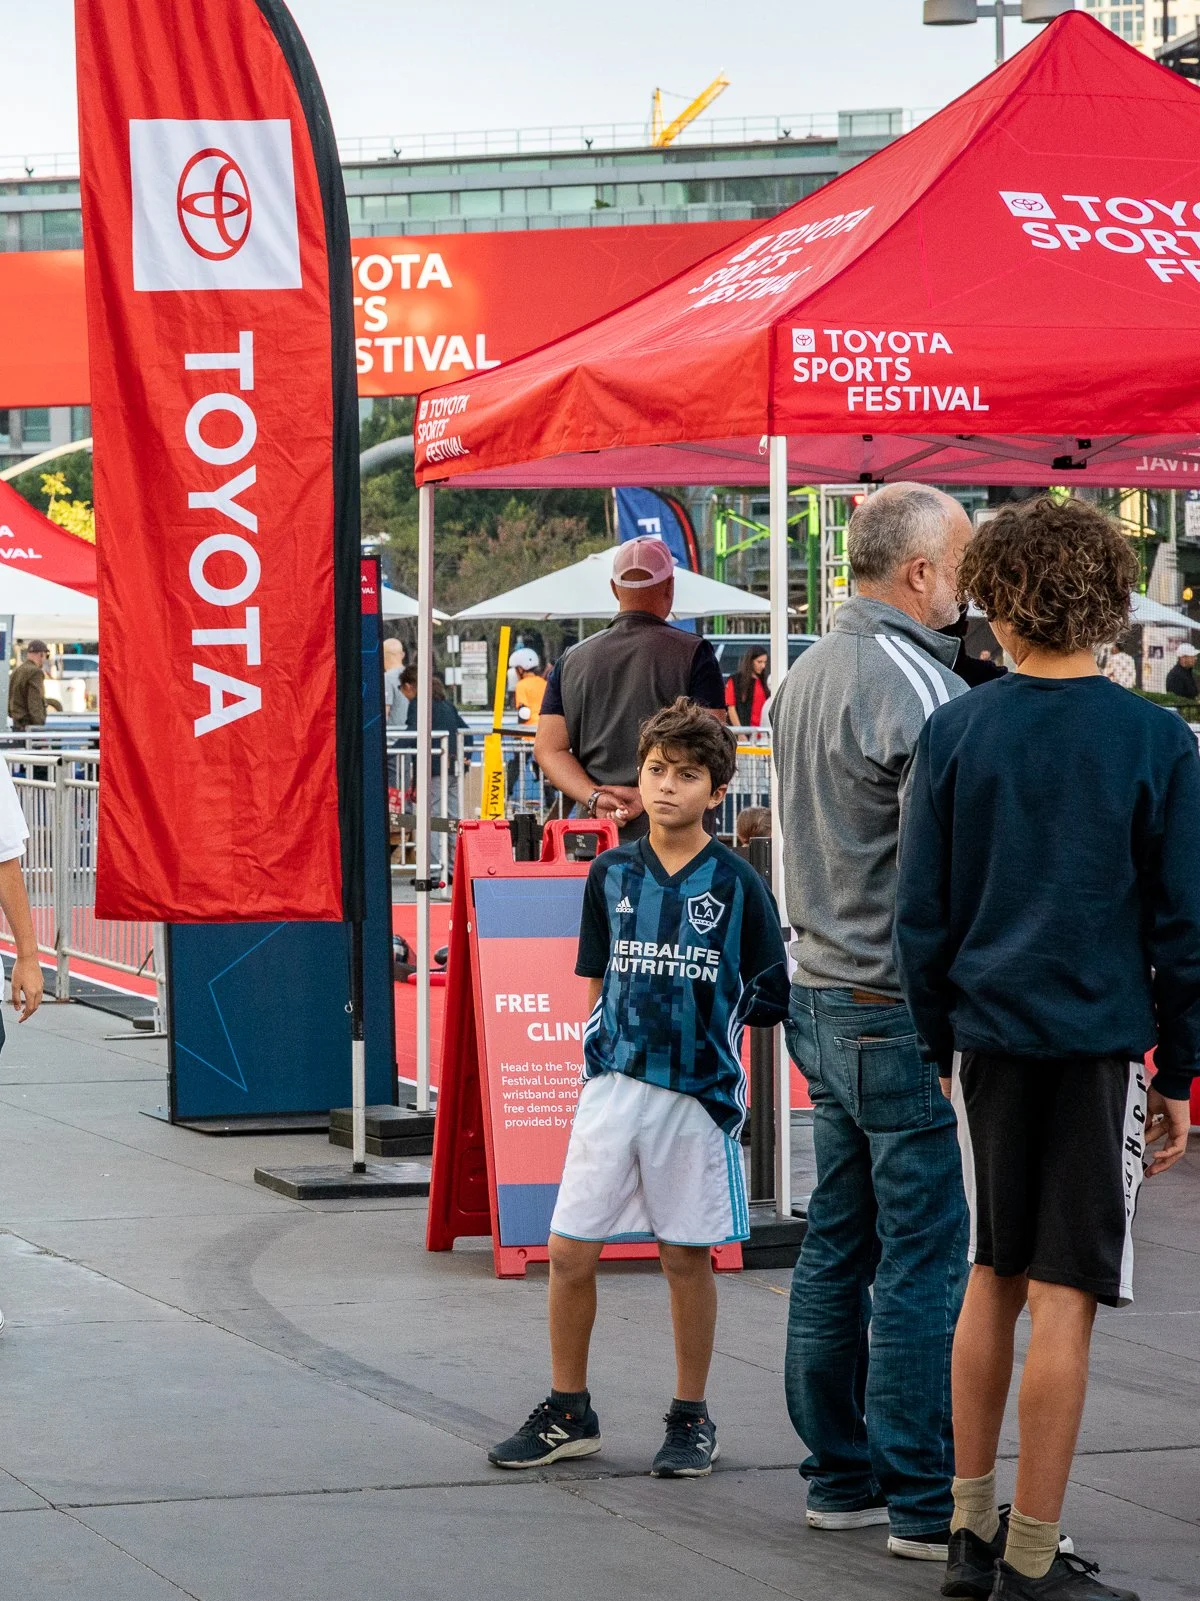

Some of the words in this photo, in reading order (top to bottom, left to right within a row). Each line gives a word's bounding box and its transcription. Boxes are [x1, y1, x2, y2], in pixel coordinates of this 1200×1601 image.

[1061, 194, 1200, 227] TOY
[757, 205, 875, 257] TOYOTA
[1021, 221, 1200, 256] SPOR
[351, 253, 453, 291] OTA
[355, 334, 501, 374] STIVAL
[823, 329, 953, 354] TOYOTA
[793, 356, 912, 383] SPORTS
[429, 394, 470, 418] TOYOTA
[847, 385, 990, 412] FESTIVAL
[417, 418, 450, 444] SPORTS
[426, 435, 470, 463] FESTIVAL
[184, 330, 262, 738] TOYOTA
[694, 905, 714, 920] LA
[611, 956, 718, 983] NUTRITION
[495, 993, 551, 1013] FREE
[527, 1022, 587, 1041] CLINI
[500, 1062, 529, 1072] Head
[531, 1063, 542, 1072] to
[545, 1061, 563, 1072] the
[565, 1061, 582, 1073] Toy
[501, 1075, 541, 1086] Festival
[545, 1075, 584, 1087] Lounge
[503, 1089, 556, 1100] wristband
[558, 1088, 579, 1099] and
[503, 1103, 524, 1113] free
[527, 1102, 563, 1113] demos
[505, 1117, 552, 1129] provided
[555, 1116, 567, 1129] by
